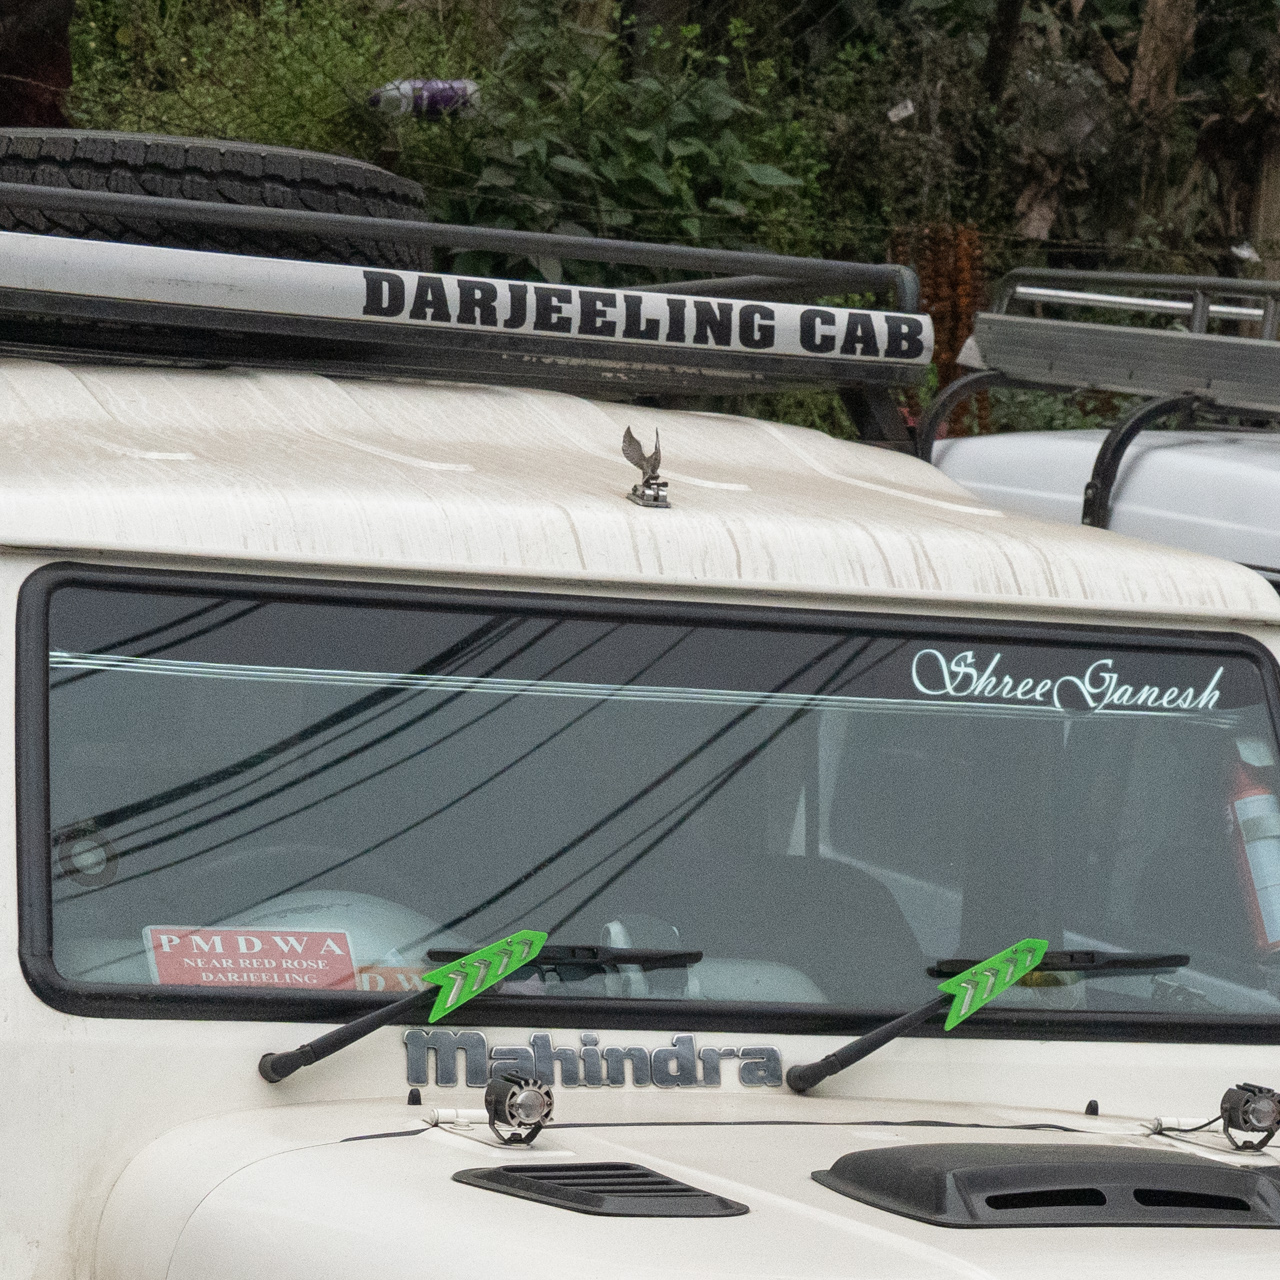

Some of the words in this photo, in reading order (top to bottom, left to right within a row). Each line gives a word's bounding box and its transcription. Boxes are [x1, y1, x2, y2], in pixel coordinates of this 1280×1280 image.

[362, 270, 775, 349] DARJEELING
[798, 307, 924, 360] CAB
[911, 649, 1053, 697] Shree
[1053, 659, 1224, 709] Ganesh
[183, 958, 235, 969] NEAR
[239, 958, 277, 970] RED
[281, 959, 329, 970] ROSE
[201, 972, 318, 985] DARJEELING
[403, 1029, 783, 1088] Mahindra
